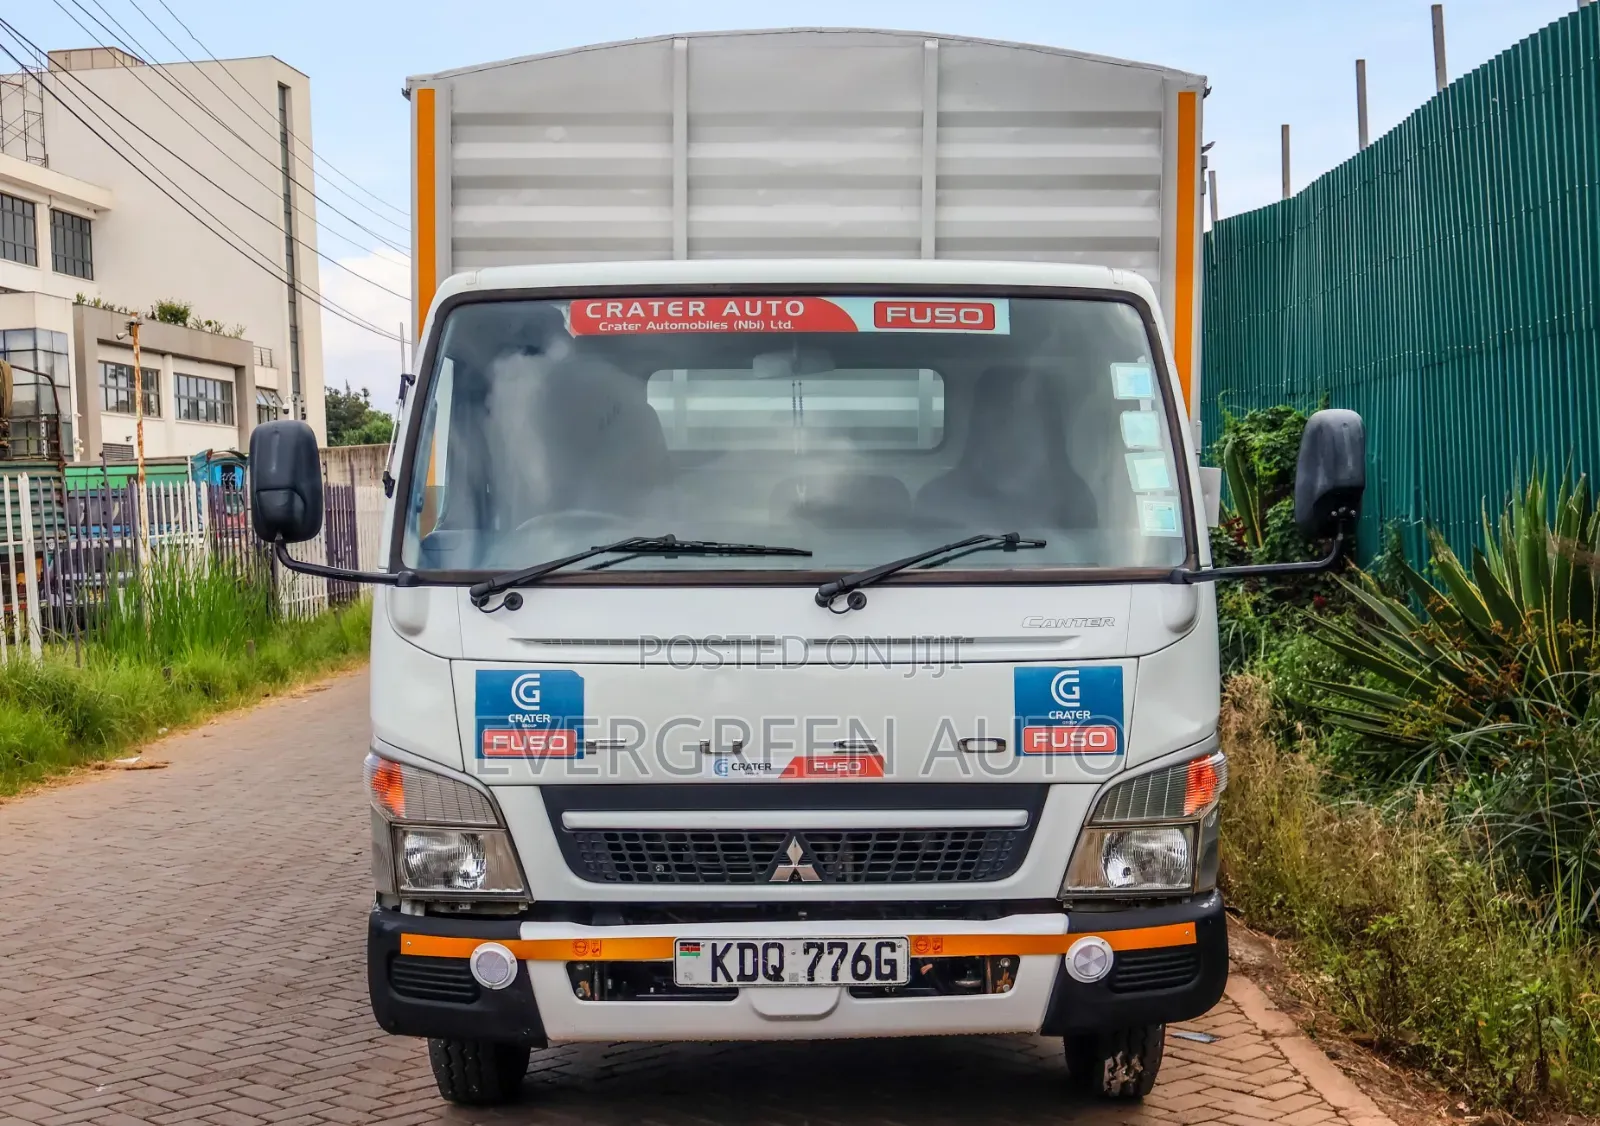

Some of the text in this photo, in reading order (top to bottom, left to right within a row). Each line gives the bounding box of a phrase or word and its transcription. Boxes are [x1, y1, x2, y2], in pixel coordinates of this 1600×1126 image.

[586, 300, 805, 318] CRATER AUTO
[886, 306, 985, 325] FUSO
[599, 319, 795, 331] Crater Automobiles (Nbi) Ltd.
[508, 714, 551, 723] CRATER
[1048, 710, 1091, 720] CRATER
[493, 735, 567, 751] FUSO
[1033, 732, 1108, 748] FUSO
[731, 762, 772, 771] CRATER
[813, 762, 861, 772] FUSO
[710, 941, 785, 982] KDQ
[803, 941, 898, 982] 776G
